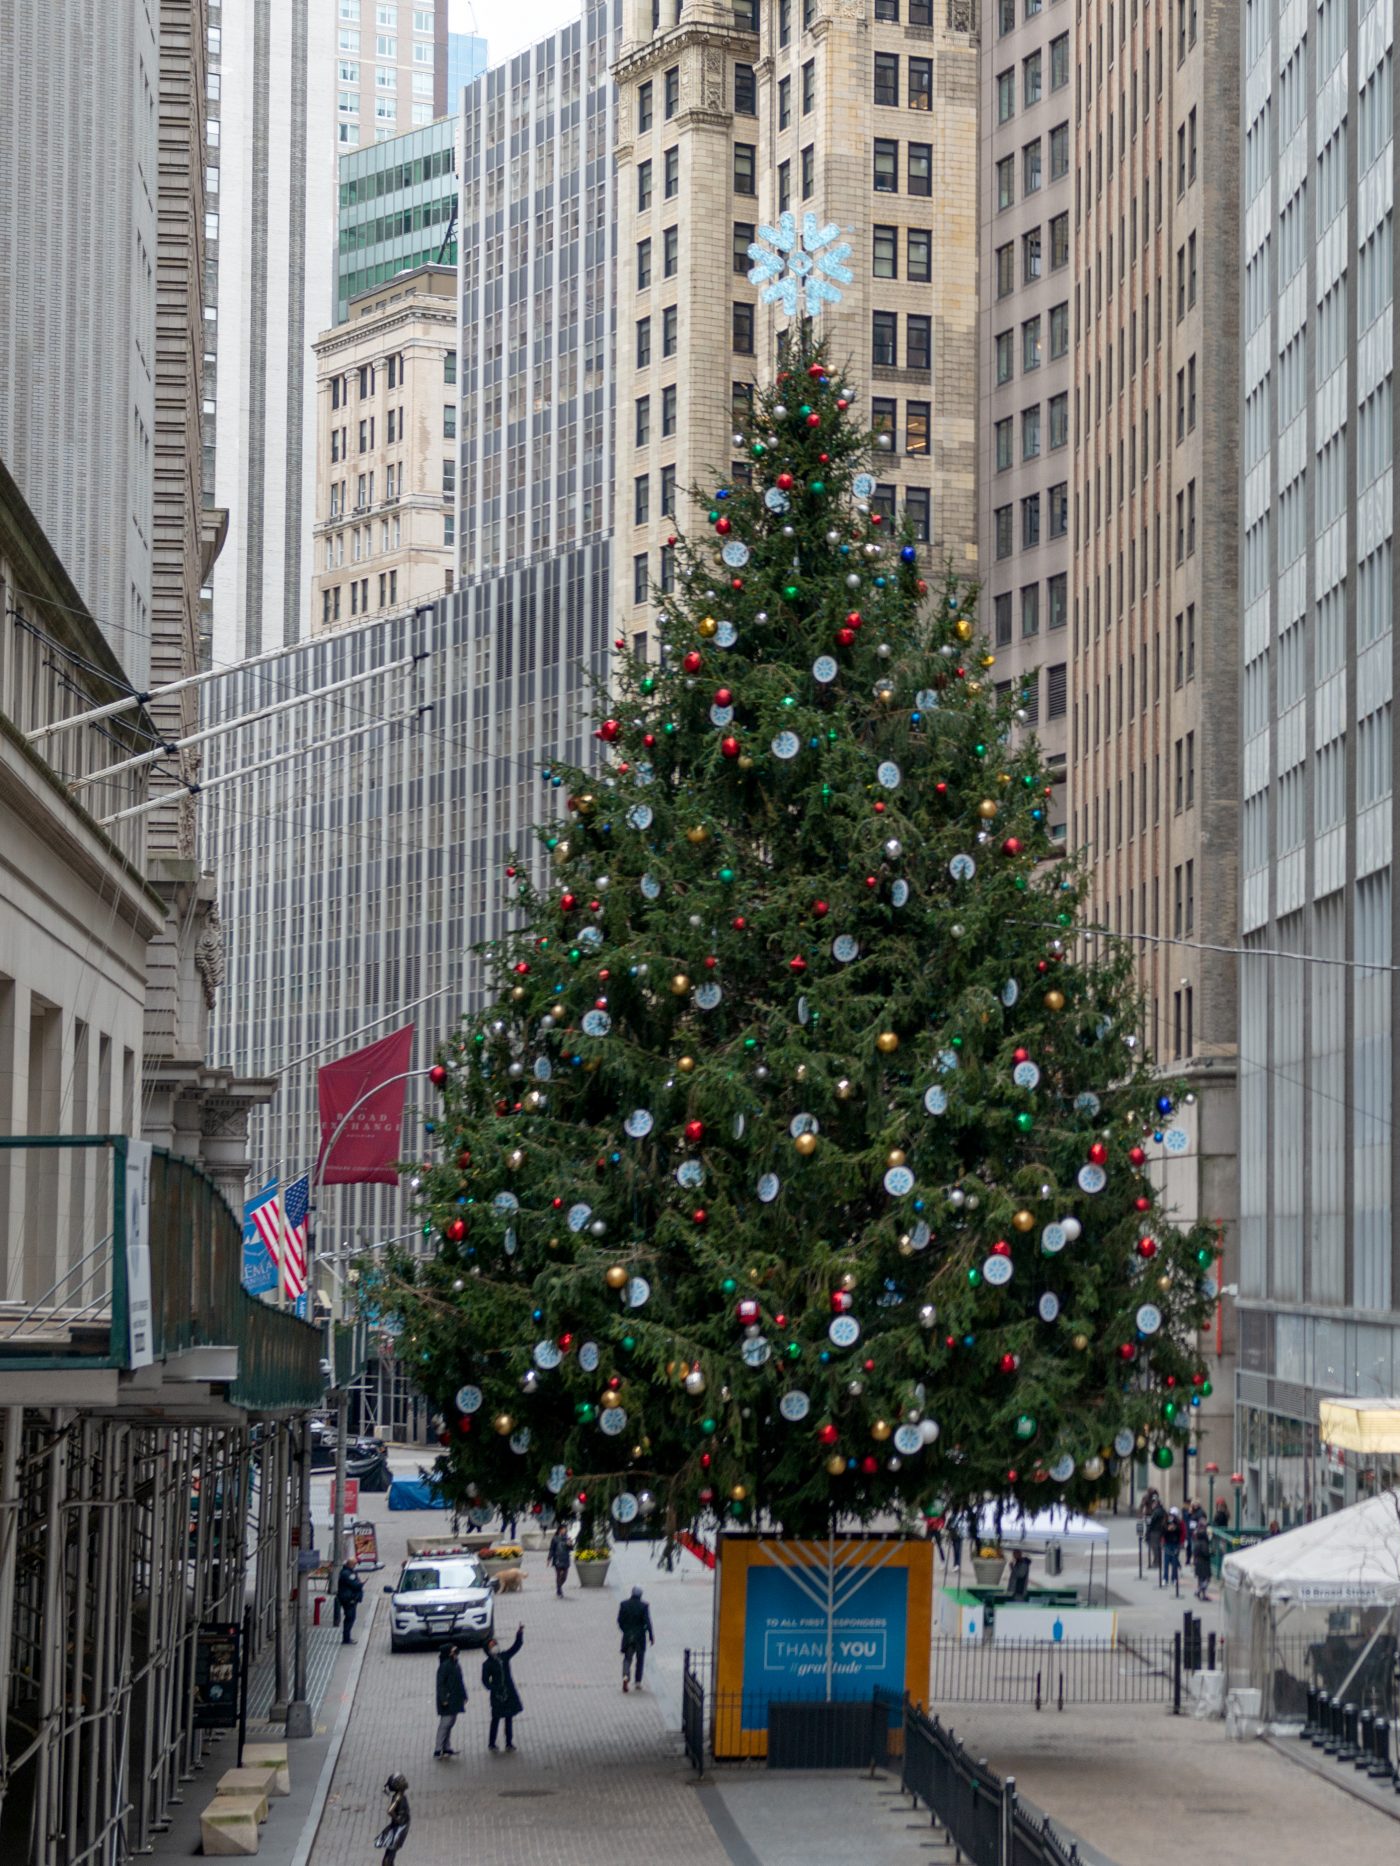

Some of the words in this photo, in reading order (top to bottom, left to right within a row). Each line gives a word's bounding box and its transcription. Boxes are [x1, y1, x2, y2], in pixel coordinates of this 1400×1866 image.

[780, 1618, 797, 1627] ALL
[799, 1618, 825, 1626] FIRST
[830, 1618, 887, 1627] ESPONDERS
[839, 1641, 877, 1657] YOU
[790, 1660, 862, 1677] #grattude
